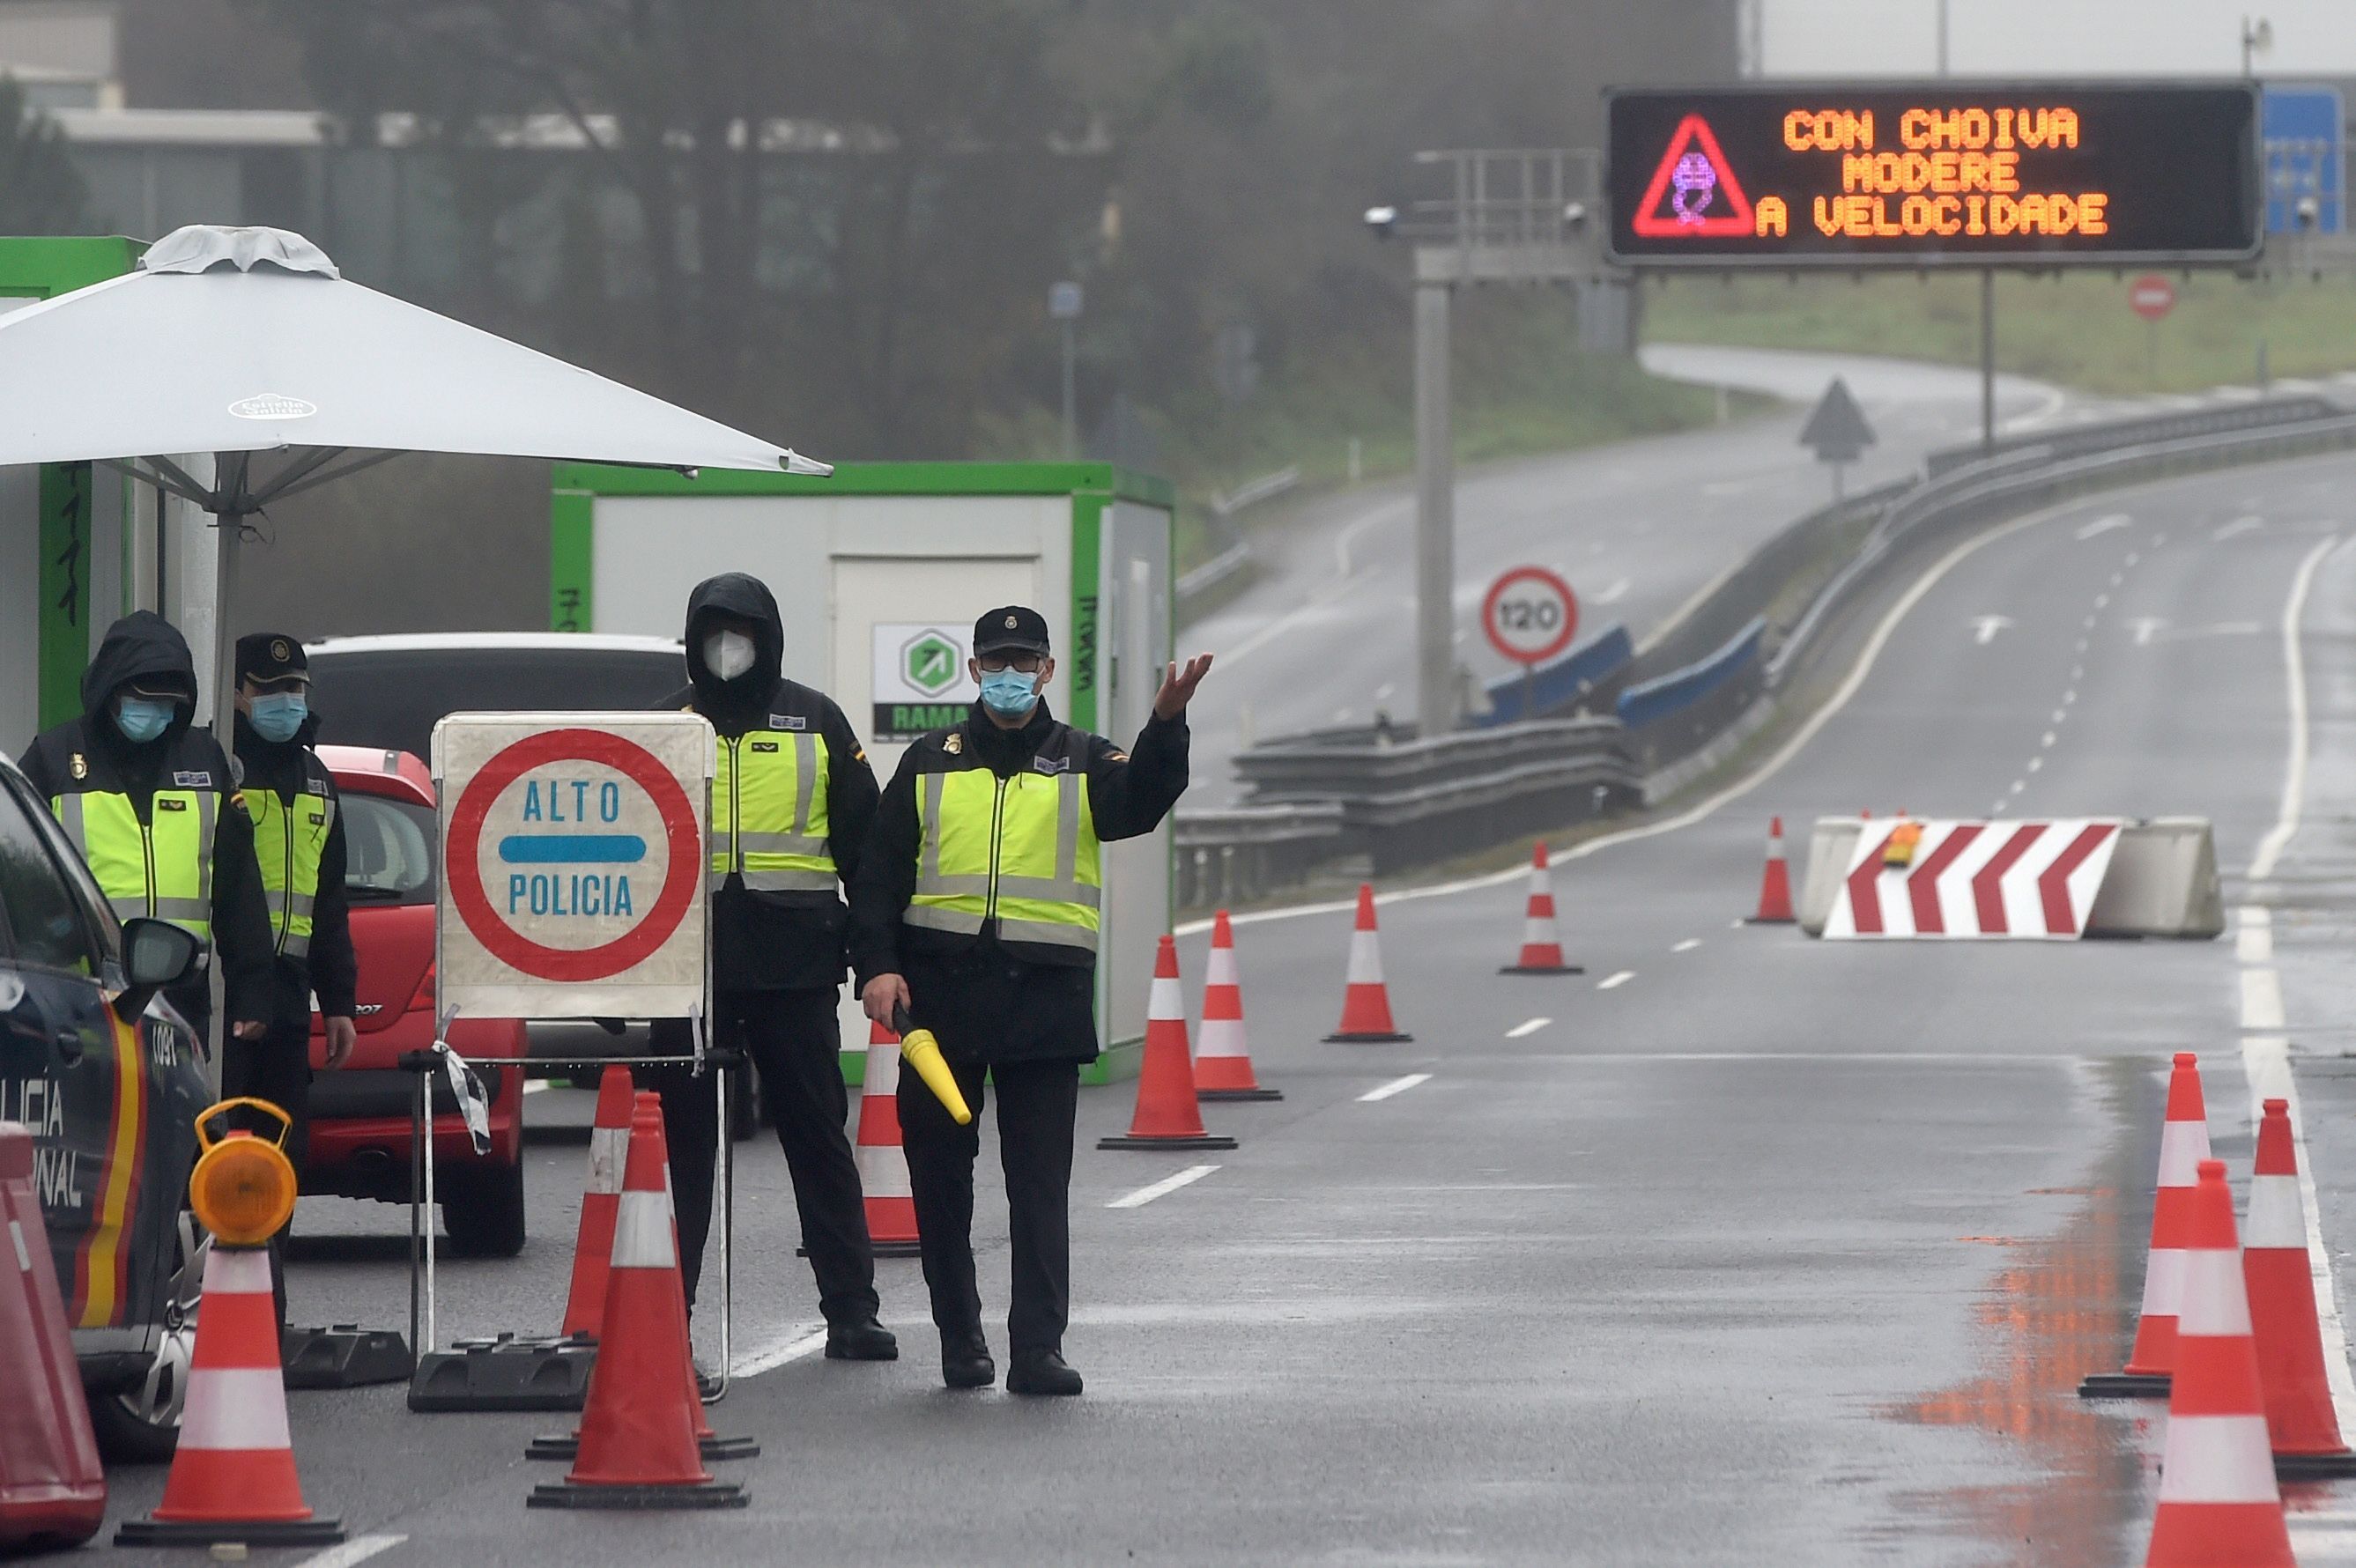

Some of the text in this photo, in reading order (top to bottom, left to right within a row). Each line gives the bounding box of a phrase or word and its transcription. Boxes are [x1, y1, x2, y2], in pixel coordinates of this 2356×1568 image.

[1784, 107, 2078, 151] CON CHOIVA
[1842, 151, 2019, 193] MODERE
[1756, 193, 2108, 237] A VELOCIDADE
[1500, 599, 1560, 631] 120
[522, 780, 619, 823] ALTO
[509, 873, 633, 917] POLICIA
